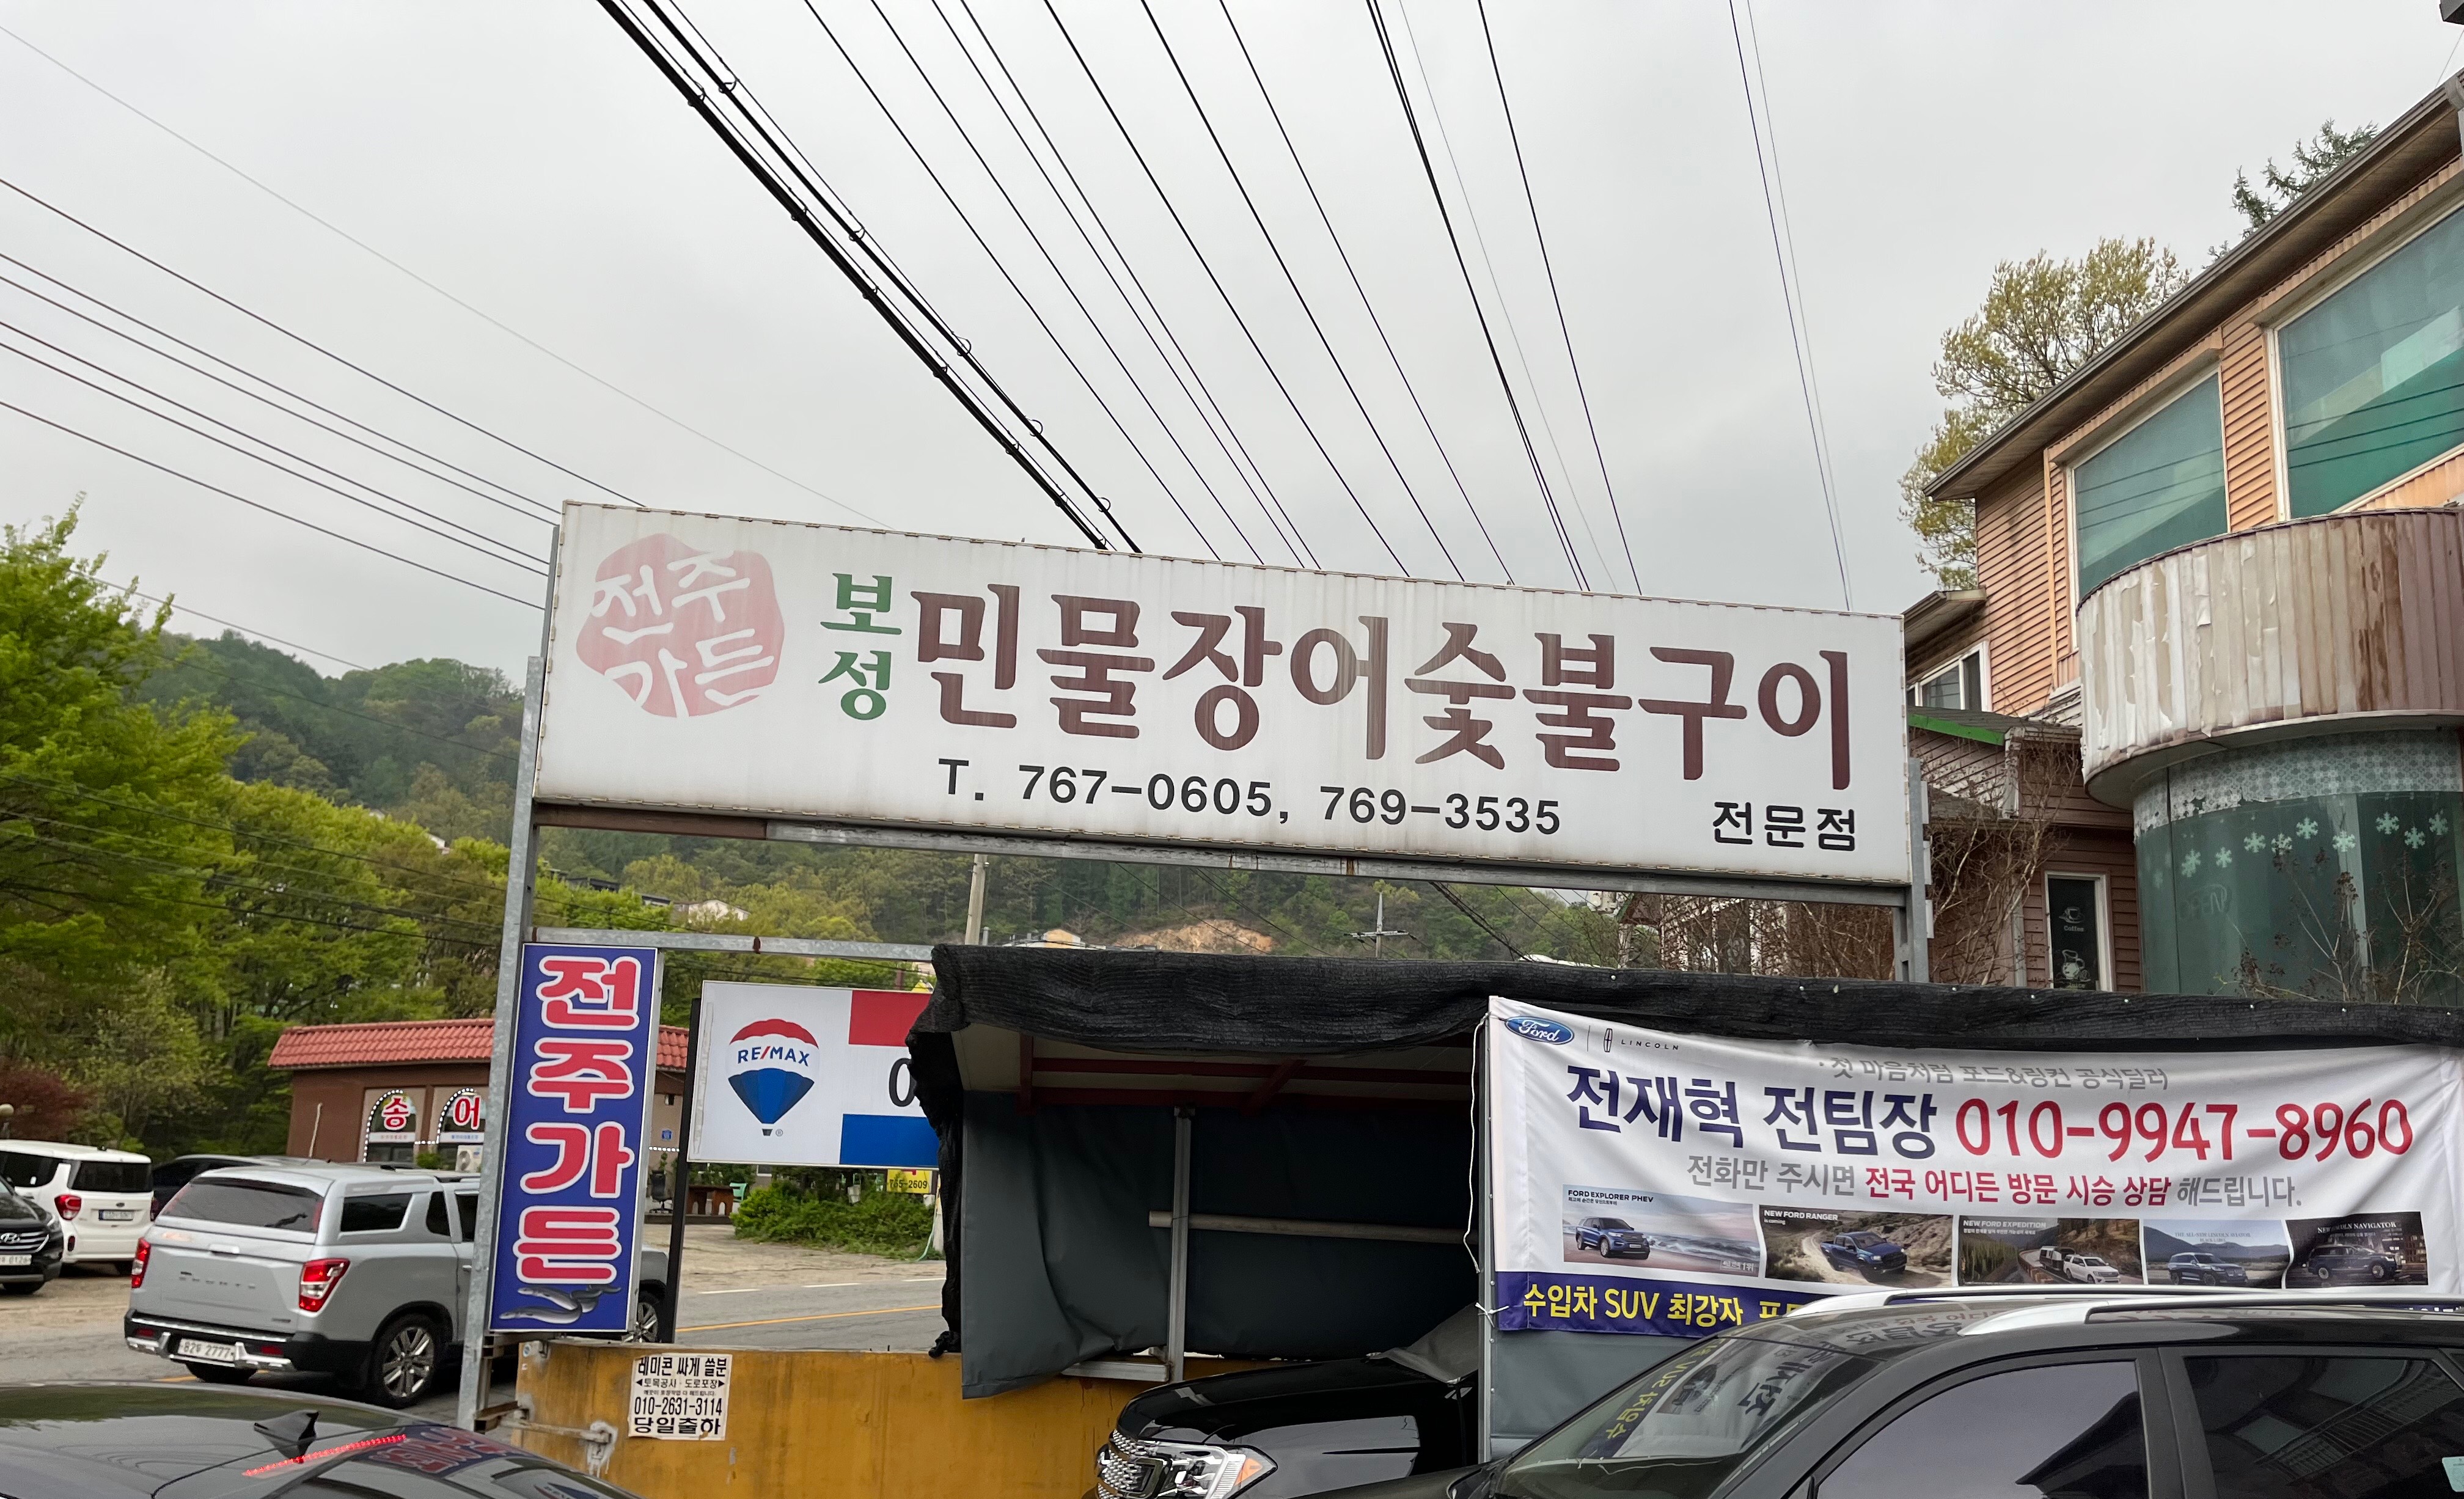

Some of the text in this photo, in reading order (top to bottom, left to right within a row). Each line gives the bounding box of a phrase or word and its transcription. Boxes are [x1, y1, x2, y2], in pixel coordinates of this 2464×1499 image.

[590, 551, 750, 645] 전주
[818, 573, 902, 720] 보성
[604, 628, 775, 717] 가든
[910, 584, 1851, 791] 민물장어숯불구이
[938, 758, 1560, 835] T. 767-0605, 769-3535
[1713, 801, 1857, 851] 전문점
[1519, 1019, 1679, 1050] Ford LINCOLN
[737, 1046, 810, 1067] RE/MAX
[1831, 1057, 2168, 1090] 첫 마음처럼 포드&링컨 공식딜러
[382, 1095, 482, 1130] 송 어
[514, 955, 640, 1285] 전주가든
[1566, 1065, 2413, 1163] 전재혁 전팀장 010-9947-8960
[1591, 1192, 1630, 1201] EXPLORER
[1687, 1155, 2302, 1207] 전화만 주시면 전국 어디든 방문 시승 상담 해드립니다.
[1805, 1212, 1838, 1221] RANGER
[1524, 1283, 1598, 1319] 수입차
[1604, 1288, 1659, 1320] SUV
[1667, 1293, 1744, 1327] 최강자
[644, 1378, 717, 1389] 토목공사 도로포장
[677, 1357, 700, 1377] 싸게
[705, 1358, 727, 1377] 쓸분
[634, 1396, 722, 1416] 010-2631-3114
[634, 1417, 721, 1435] 당일출하
